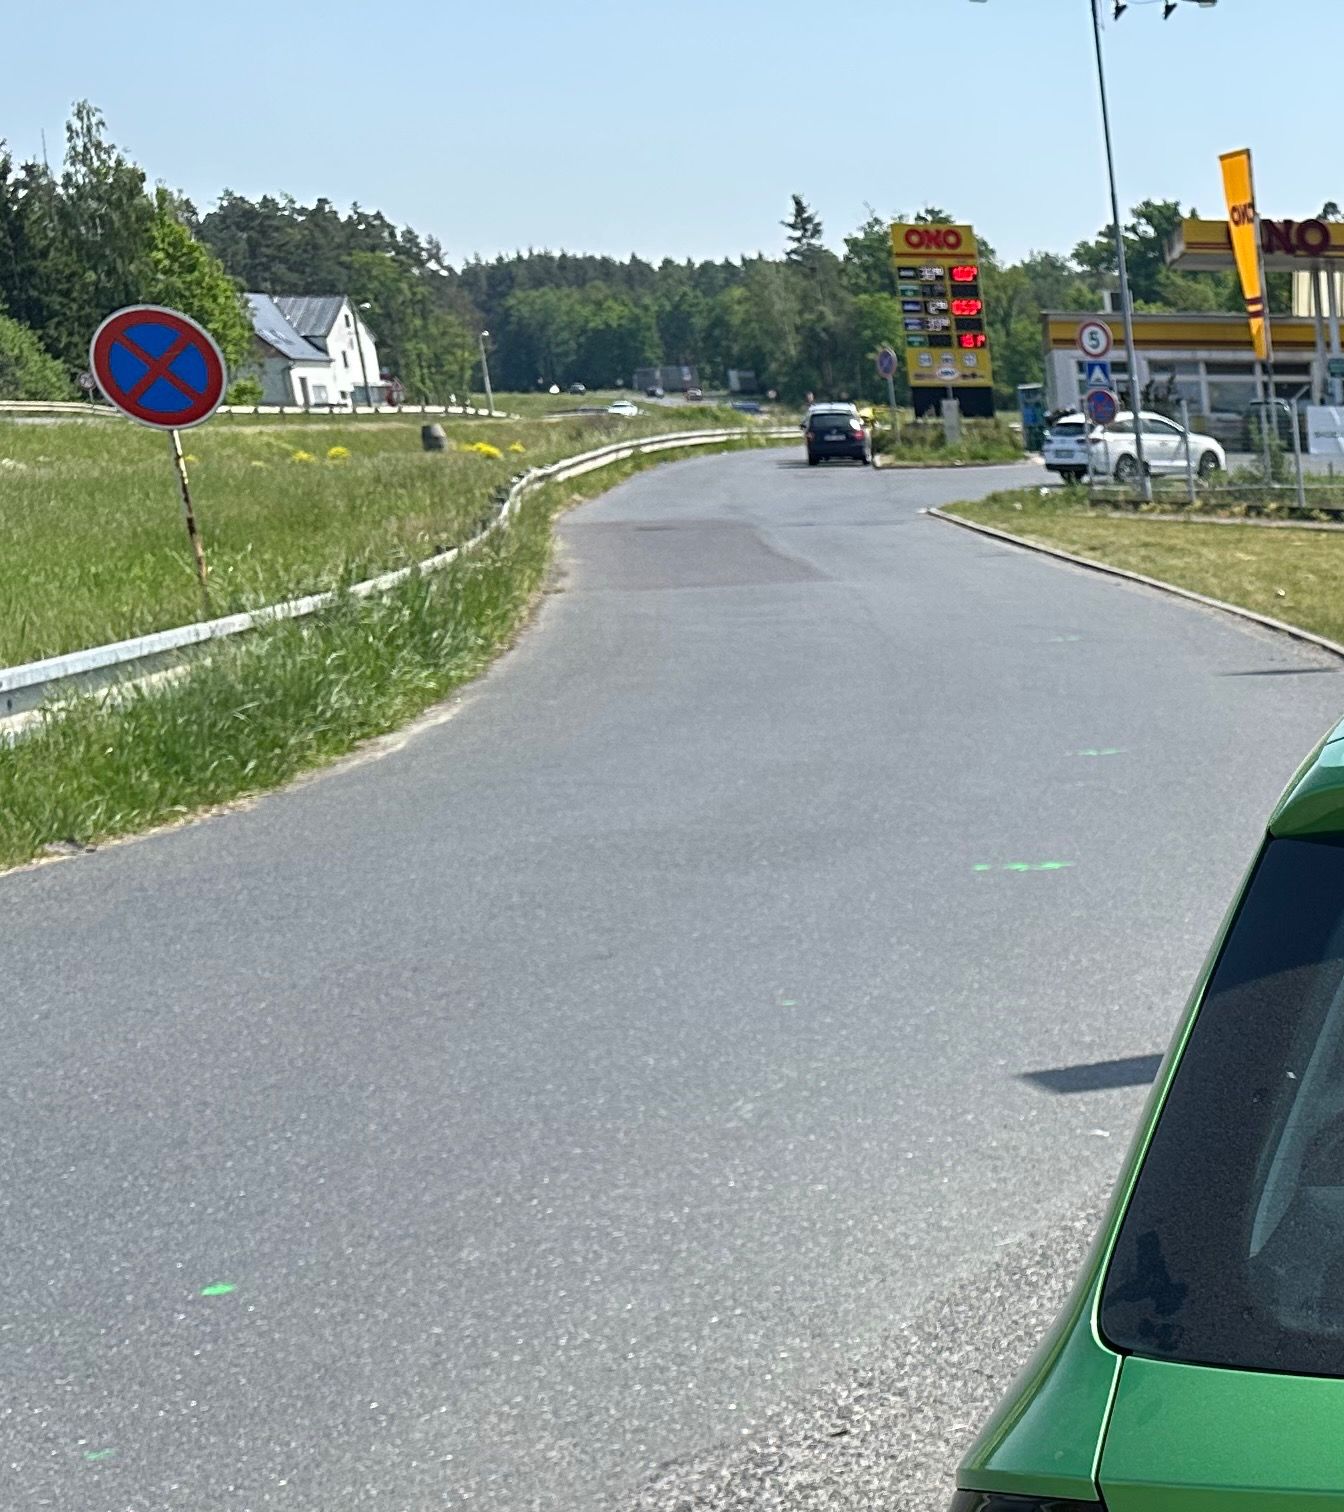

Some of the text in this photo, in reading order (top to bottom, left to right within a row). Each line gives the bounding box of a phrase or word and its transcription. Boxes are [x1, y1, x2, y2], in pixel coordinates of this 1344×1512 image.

[904, 229, 962, 250] ONO
[1227, 218, 1331, 256] NO
[1088, 330, 1101, 349] 5
